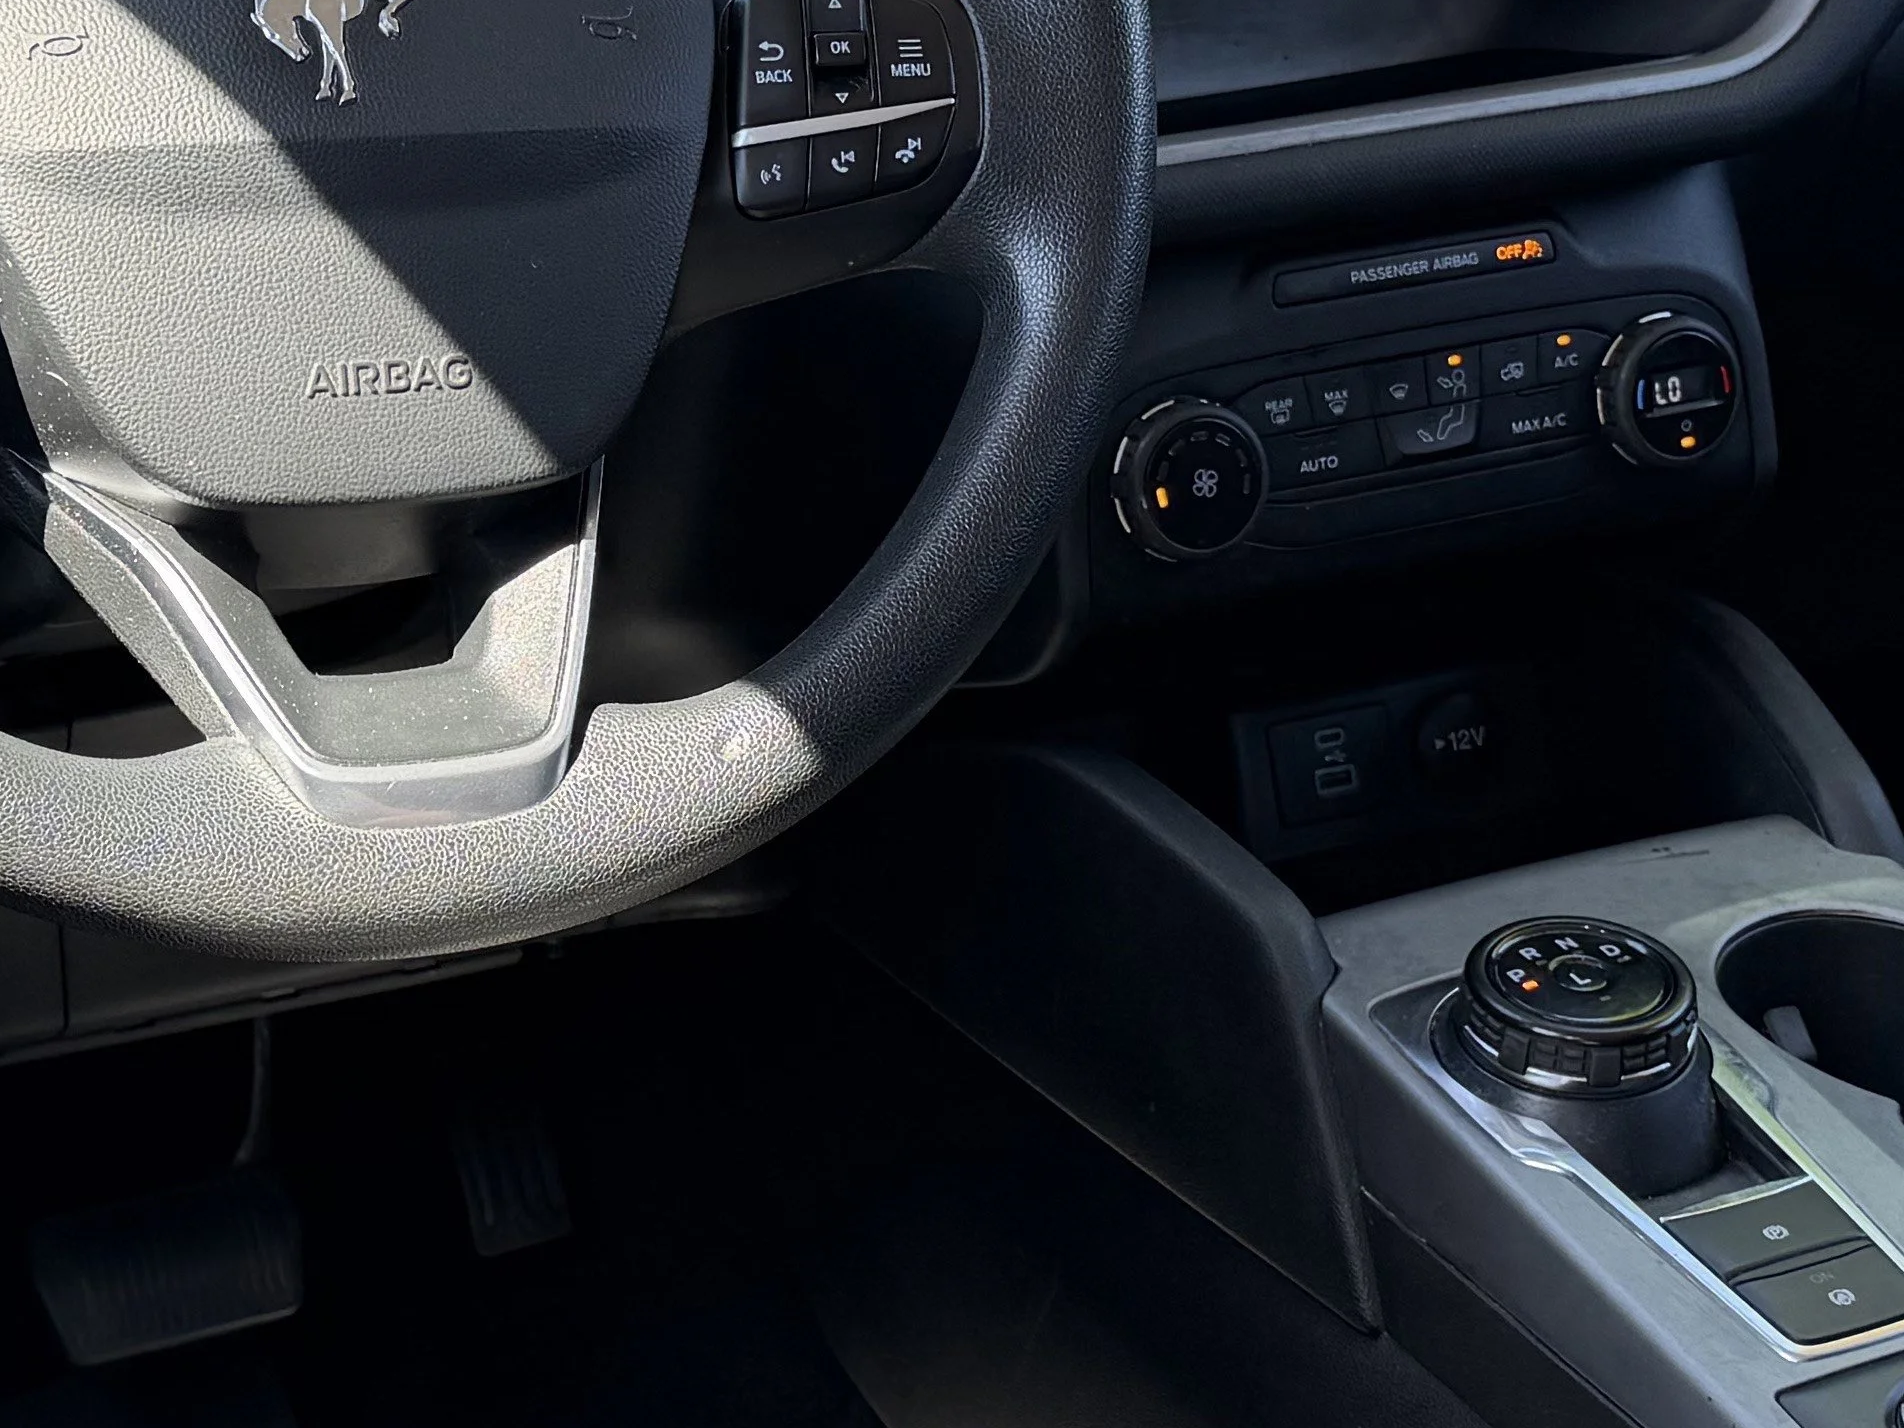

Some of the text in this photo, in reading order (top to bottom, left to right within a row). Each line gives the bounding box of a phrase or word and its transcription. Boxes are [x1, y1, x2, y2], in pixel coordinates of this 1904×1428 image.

[830, 41, 851, 55] OK
[755, 69, 793, 84] BACK
[891, 63, 931, 78] MENU
[1350, 243, 1523, 284] PASSENGER AIRBAG OFF
[1554, 353, 1579, 369] A/C
[306, 355, 474, 400] AIRBAG
[1324, 389, 1348, 402] MAX
[1264, 397, 1293, 412] REAR
[1511, 413, 1567, 435] MAX A/C
[1300, 455, 1338, 473] AUTO
[1448, 725, 1486, 751] 12V
[1506, 936, 1622, 983] P R N D
[1569, 972, 1591, 985] L
